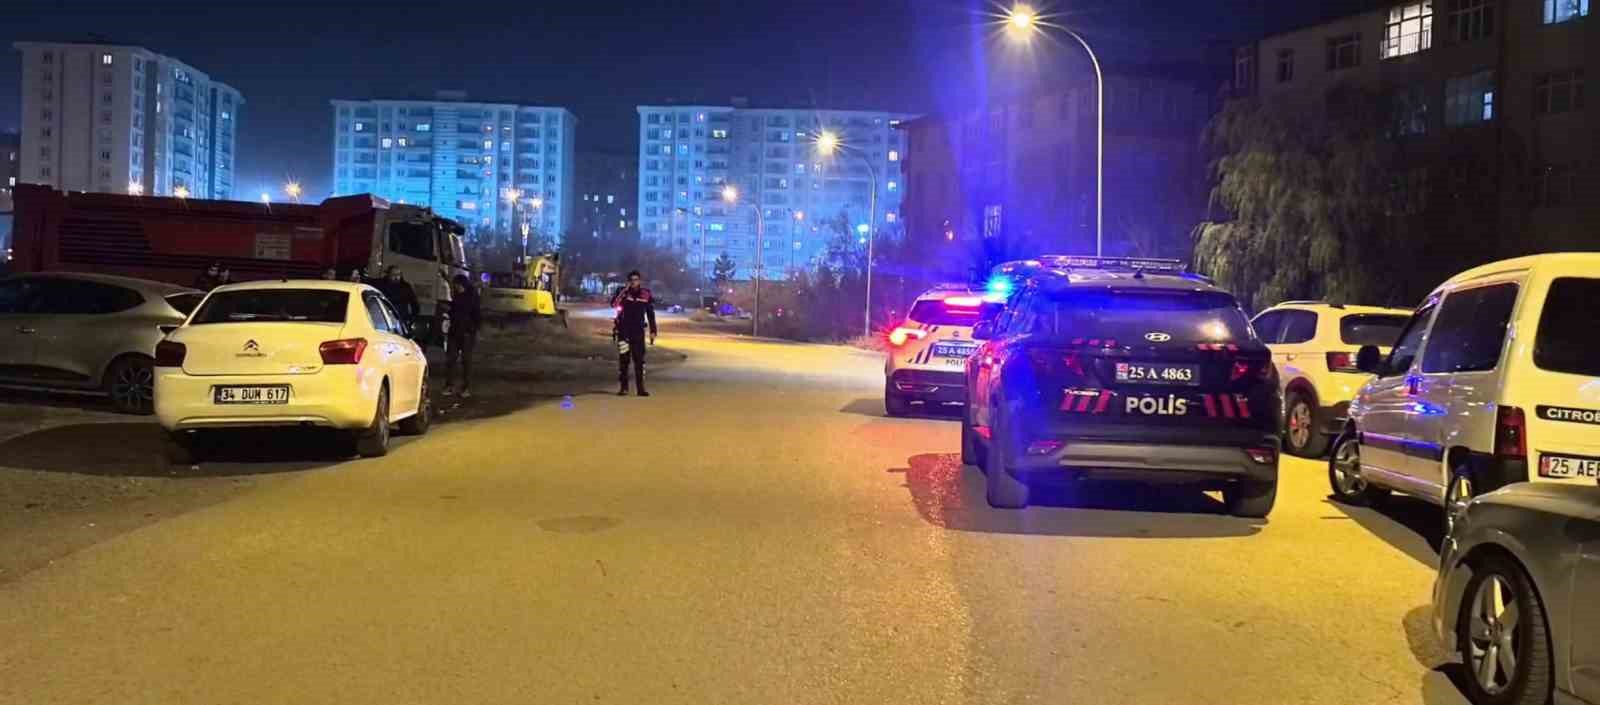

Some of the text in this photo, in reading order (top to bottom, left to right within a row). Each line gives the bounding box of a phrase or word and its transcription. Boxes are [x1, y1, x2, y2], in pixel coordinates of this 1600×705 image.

[1129, 366, 1192, 381] 25 A 4863
[223, 389, 235, 400] 34
[267, 389, 286, 400] 617
[1126, 394, 1187, 416] POLİS
[1551, 458, 1569, 474] 25
